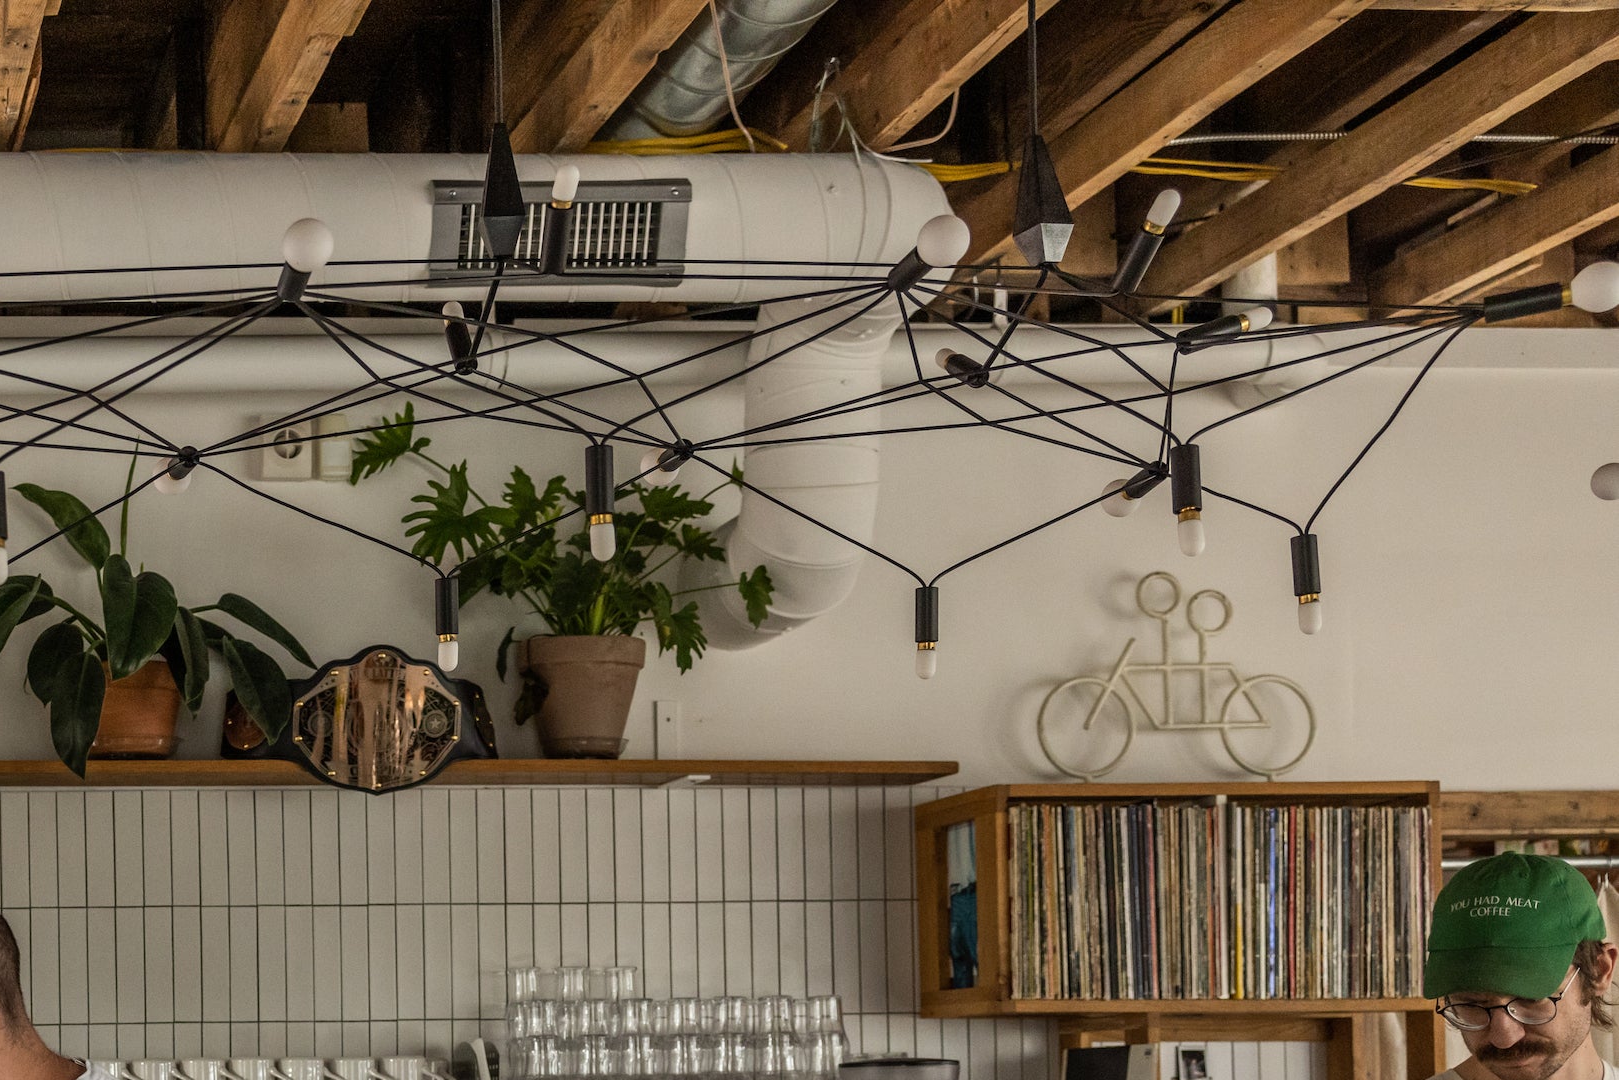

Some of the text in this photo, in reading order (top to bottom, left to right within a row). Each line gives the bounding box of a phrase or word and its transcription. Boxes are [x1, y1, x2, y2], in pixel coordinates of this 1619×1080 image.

[1451, 896, 1540, 912] YOU HAD MEAT
[1470, 907, 1511, 917] COFFEE
